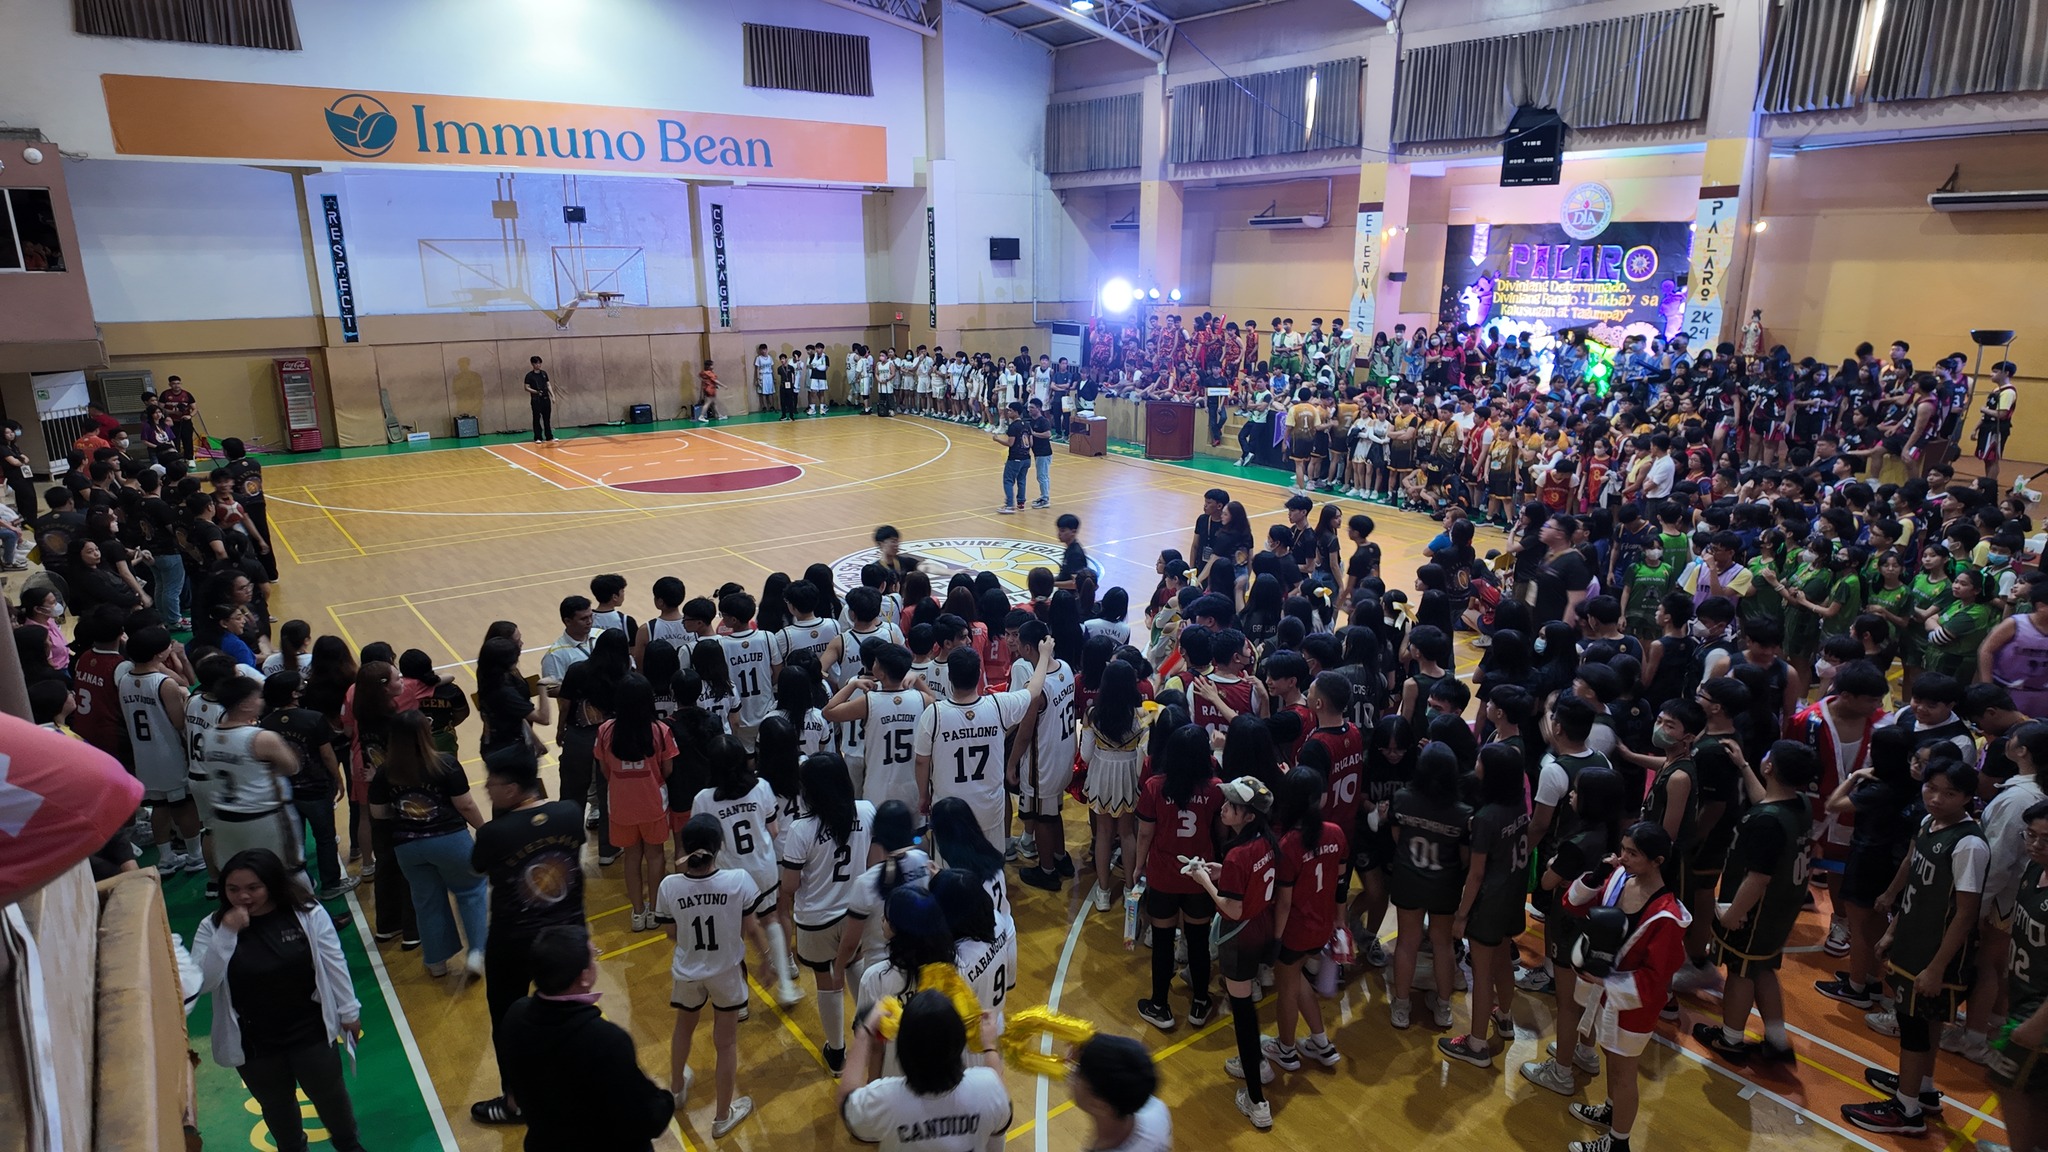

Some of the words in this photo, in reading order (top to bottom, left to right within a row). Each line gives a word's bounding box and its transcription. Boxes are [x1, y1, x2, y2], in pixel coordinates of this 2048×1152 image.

[412, 104, 645, 162] Immuno
[656, 119, 774, 168] Bean
[711, 207, 729, 312] COURAGE
[1507, 243, 1659, 283] PALARO
[1701, 200, 1724, 302] PALARO
[327, 210, 354, 328] RESPECT
[928, 210, 936, 326] DISCIPLINE
[1357, 214, 1373, 333] ETERNALS
[1556, 307, 1569, 318] at
[1588, 294, 1636, 306] Lakbay
[1640, 295, 1659, 306] sa
[1691, 310, 1714, 324] 2K
[1689, 326, 1709, 340] 24
[1303, 416, 1309, 428] 1
[1593, 469, 1600, 480] 8
[1551, 493, 1559, 502] 9
[928, 540, 1007, 548] DIVINE
[730, 652, 763, 666] CALUB
[990, 641, 998, 660] 2
[76, 670, 104, 688] PLANAS
[738, 667, 761, 697] 11
[77, 688, 92, 715] 3
[1353, 702, 1376, 729] 10
[133, 710, 151, 741] 6
[881, 713, 916, 725] ORACION
[942, 726, 998, 742] PASILONG
[1059, 700, 1075, 741] 12
[883, 729, 914, 765] 15
[954, 744, 990, 783] 17
[1332, 772, 1358, 809] 10
[718, 802, 757, 820] SANTOS
[1176, 810, 1198, 838] 3
[732, 820, 755, 855] 6
[1933, 842, 1943, 854] S
[832, 844, 851, 882] 2
[1409, 836, 1443, 871] 01
[1510, 834, 1528, 873] 13
[1315, 863, 1324, 893] 1
[678, 893, 728, 910] DAYUNO
[691, 915, 719, 951] 11
[992, 963, 1006, 1007] 9
[896, 1113, 981, 1143] CANDIDO
